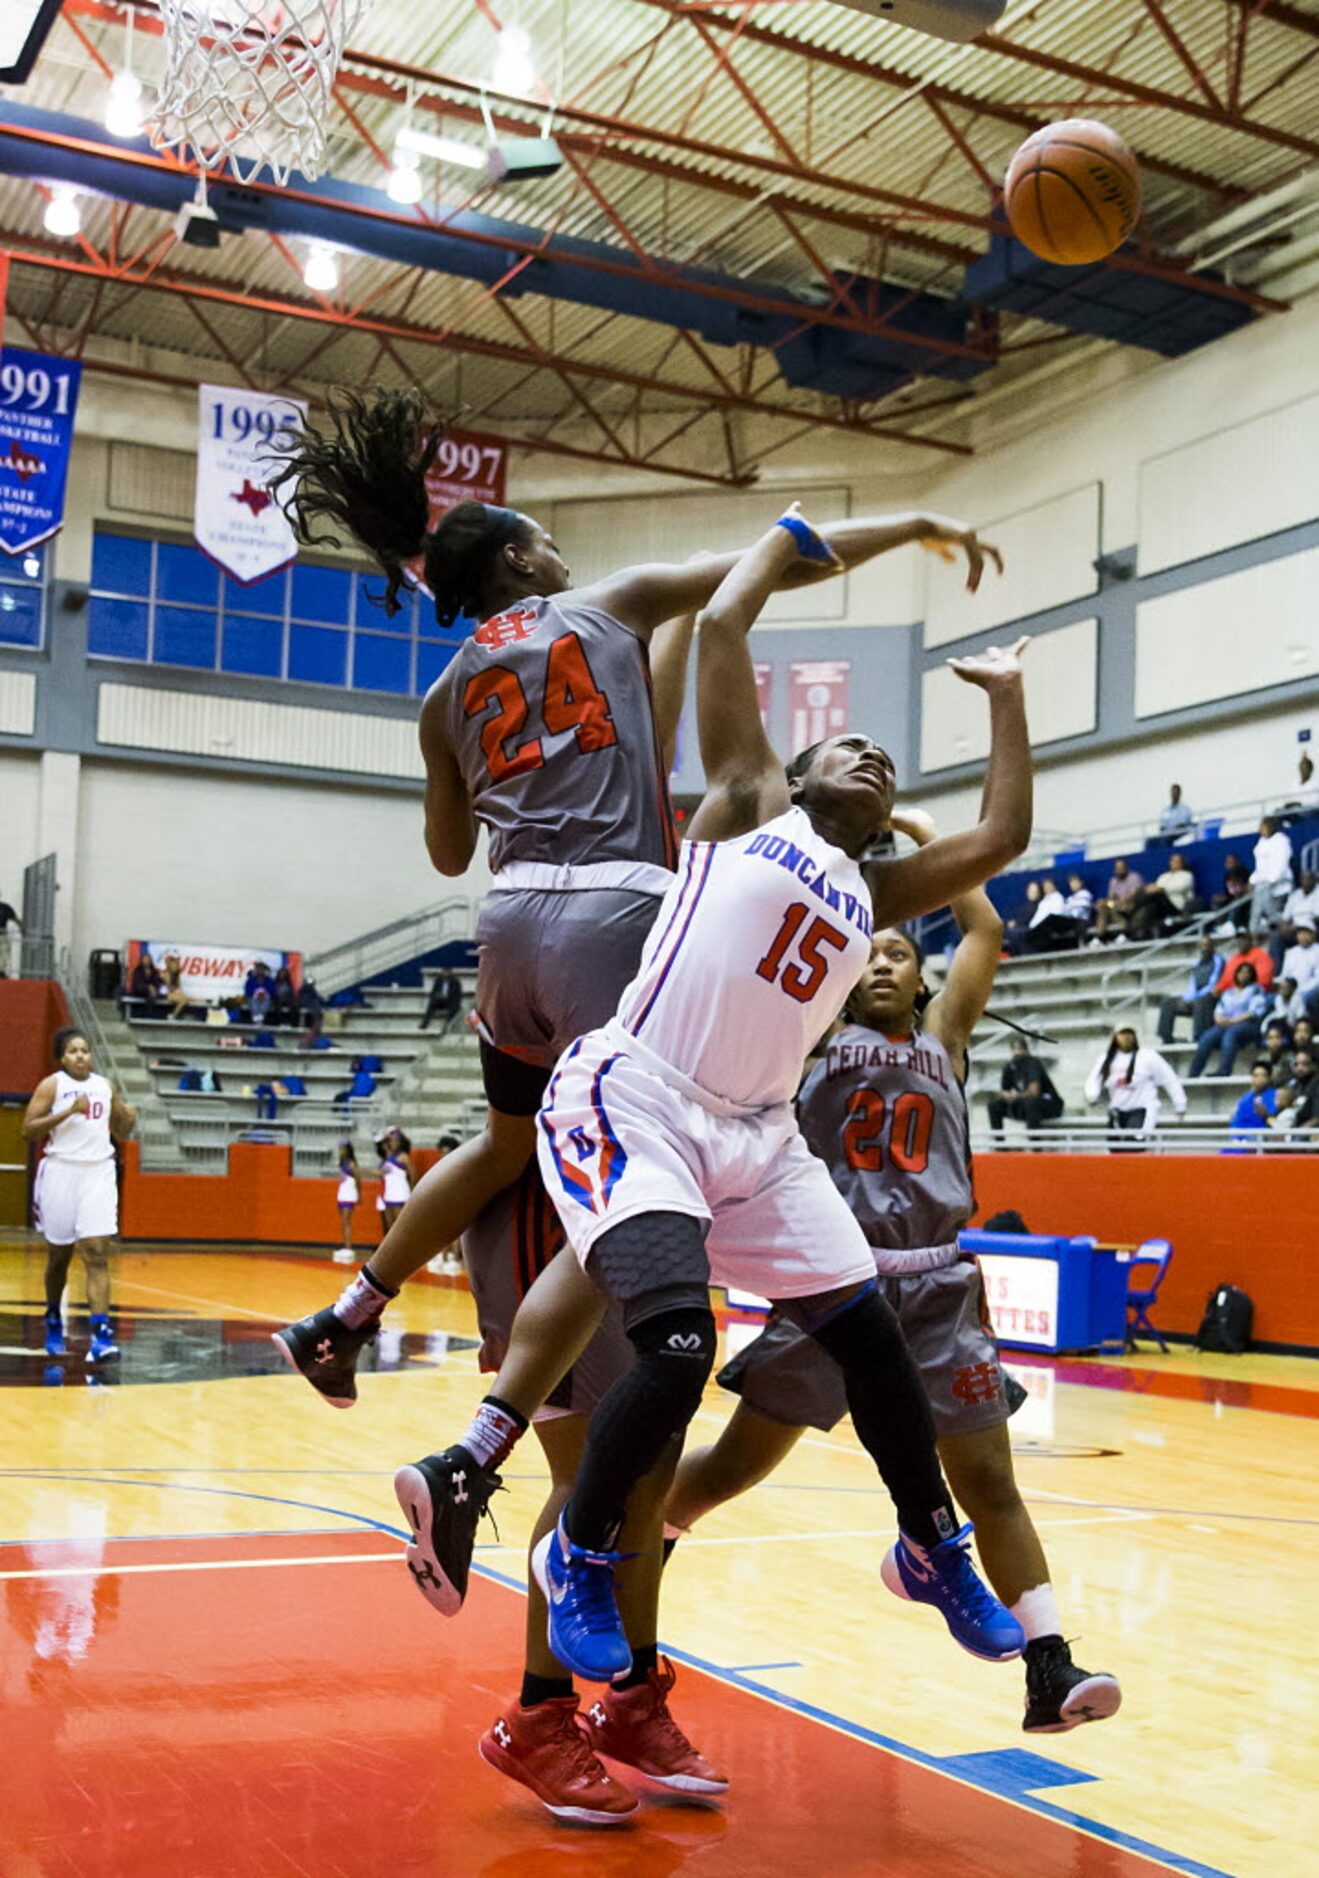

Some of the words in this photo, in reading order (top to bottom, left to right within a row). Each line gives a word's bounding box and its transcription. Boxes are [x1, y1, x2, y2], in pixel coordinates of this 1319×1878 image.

[1, 365, 70, 415] 991
[464, 631, 618, 782] 24
[178, 956, 246, 977] UBWAY
[755, 902, 849, 1003] 15
[825, 1045, 898, 1082] CEDAR
[906, 1047, 949, 1090] HILL
[842, 1088, 935, 1174] 20
